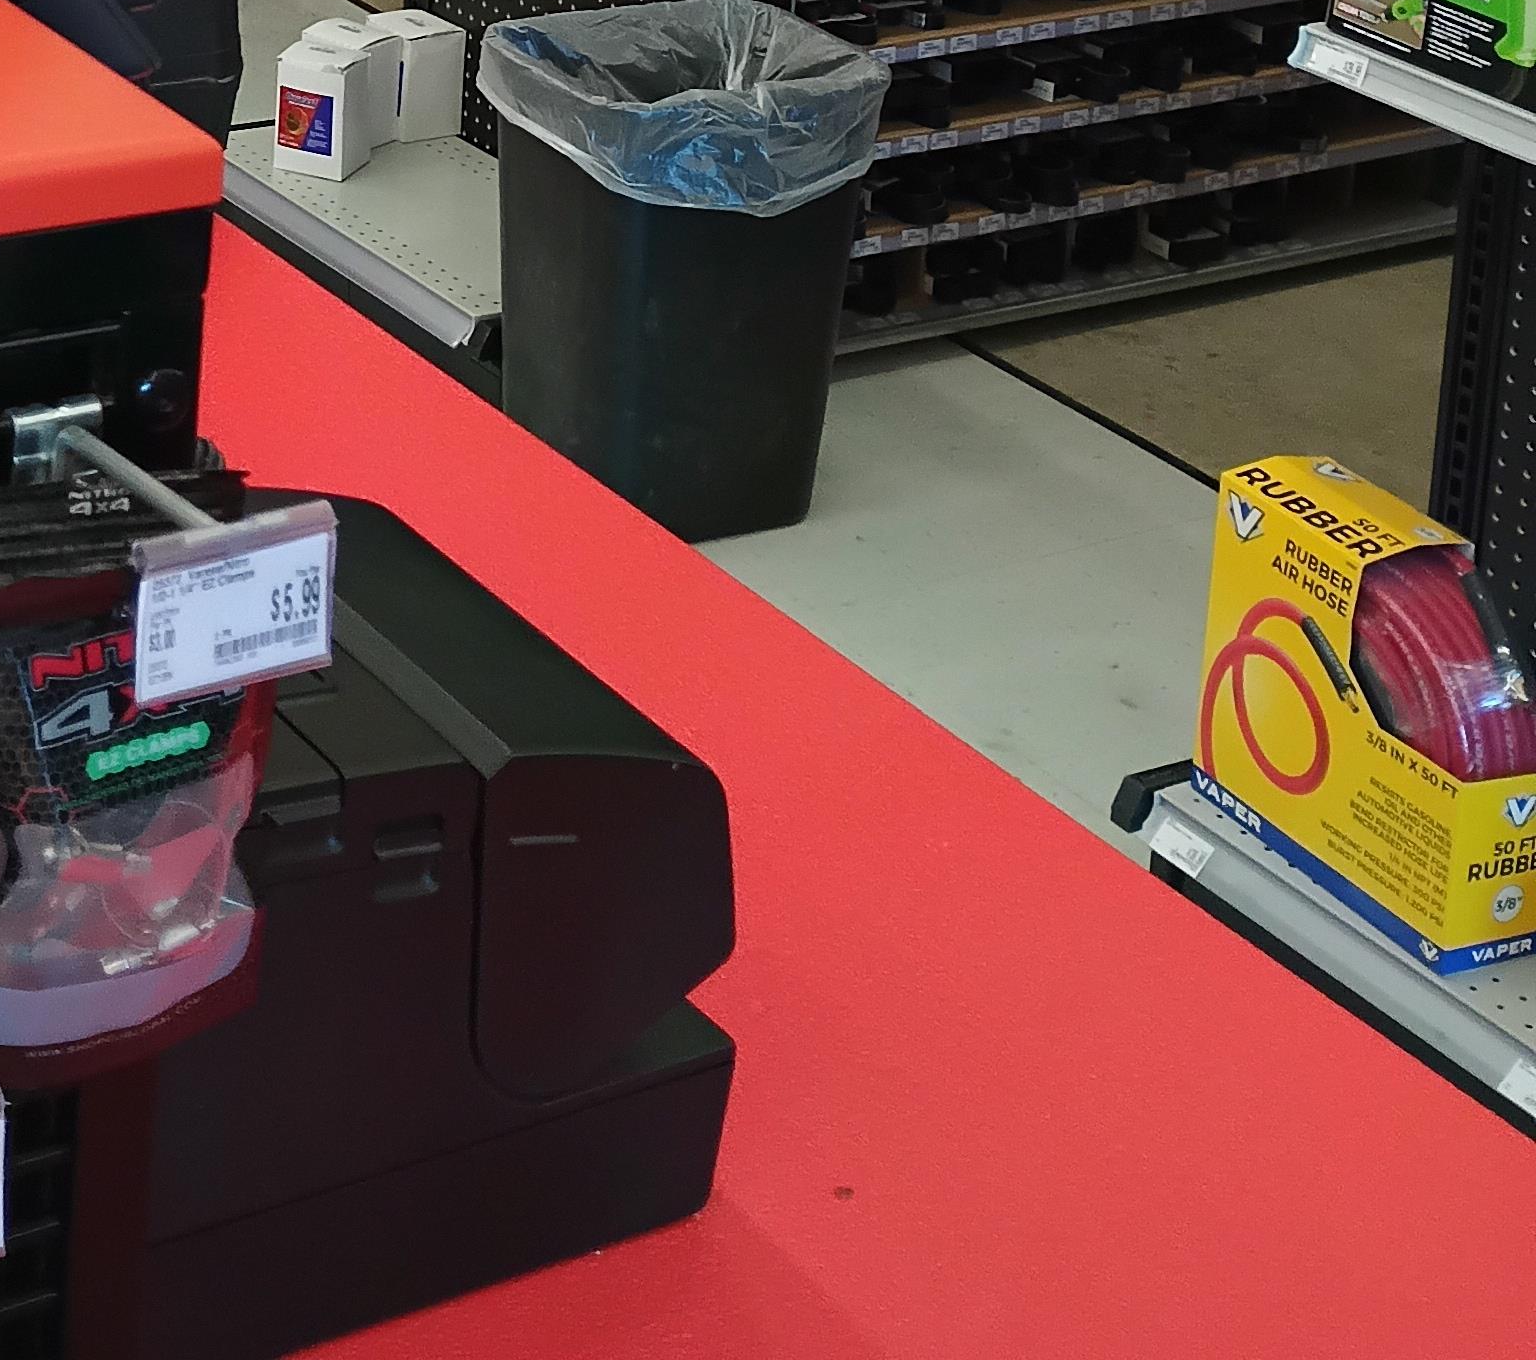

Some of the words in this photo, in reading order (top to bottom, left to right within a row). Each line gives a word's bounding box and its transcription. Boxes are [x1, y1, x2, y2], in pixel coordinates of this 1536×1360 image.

[1235, 467, 1384, 559] RUBBER
[1378, 532, 1406, 548] FT
[1271, 555, 1300, 584] AIR
[1301, 574, 1349, 618] HOSE
[1284, 538, 1353, 597] RUBBER
[270, 574, 321, 623] $5.99
[1366, 729, 1388, 754] 3/8
[1390, 745, 1406, 766] IN
[1408, 758, 1419, 775] X
[1421, 767, 1440, 788] 50
[1440, 780, 1460, 800] FT
[1194, 768, 1263, 836] VAPER
[1467, 852, 1536, 884] RUBBE
[1493, 839, 1515, 858] 50
[1494, 894, 1525, 915] 3/8"
[1471, 935, 1534, 964] VAPER
